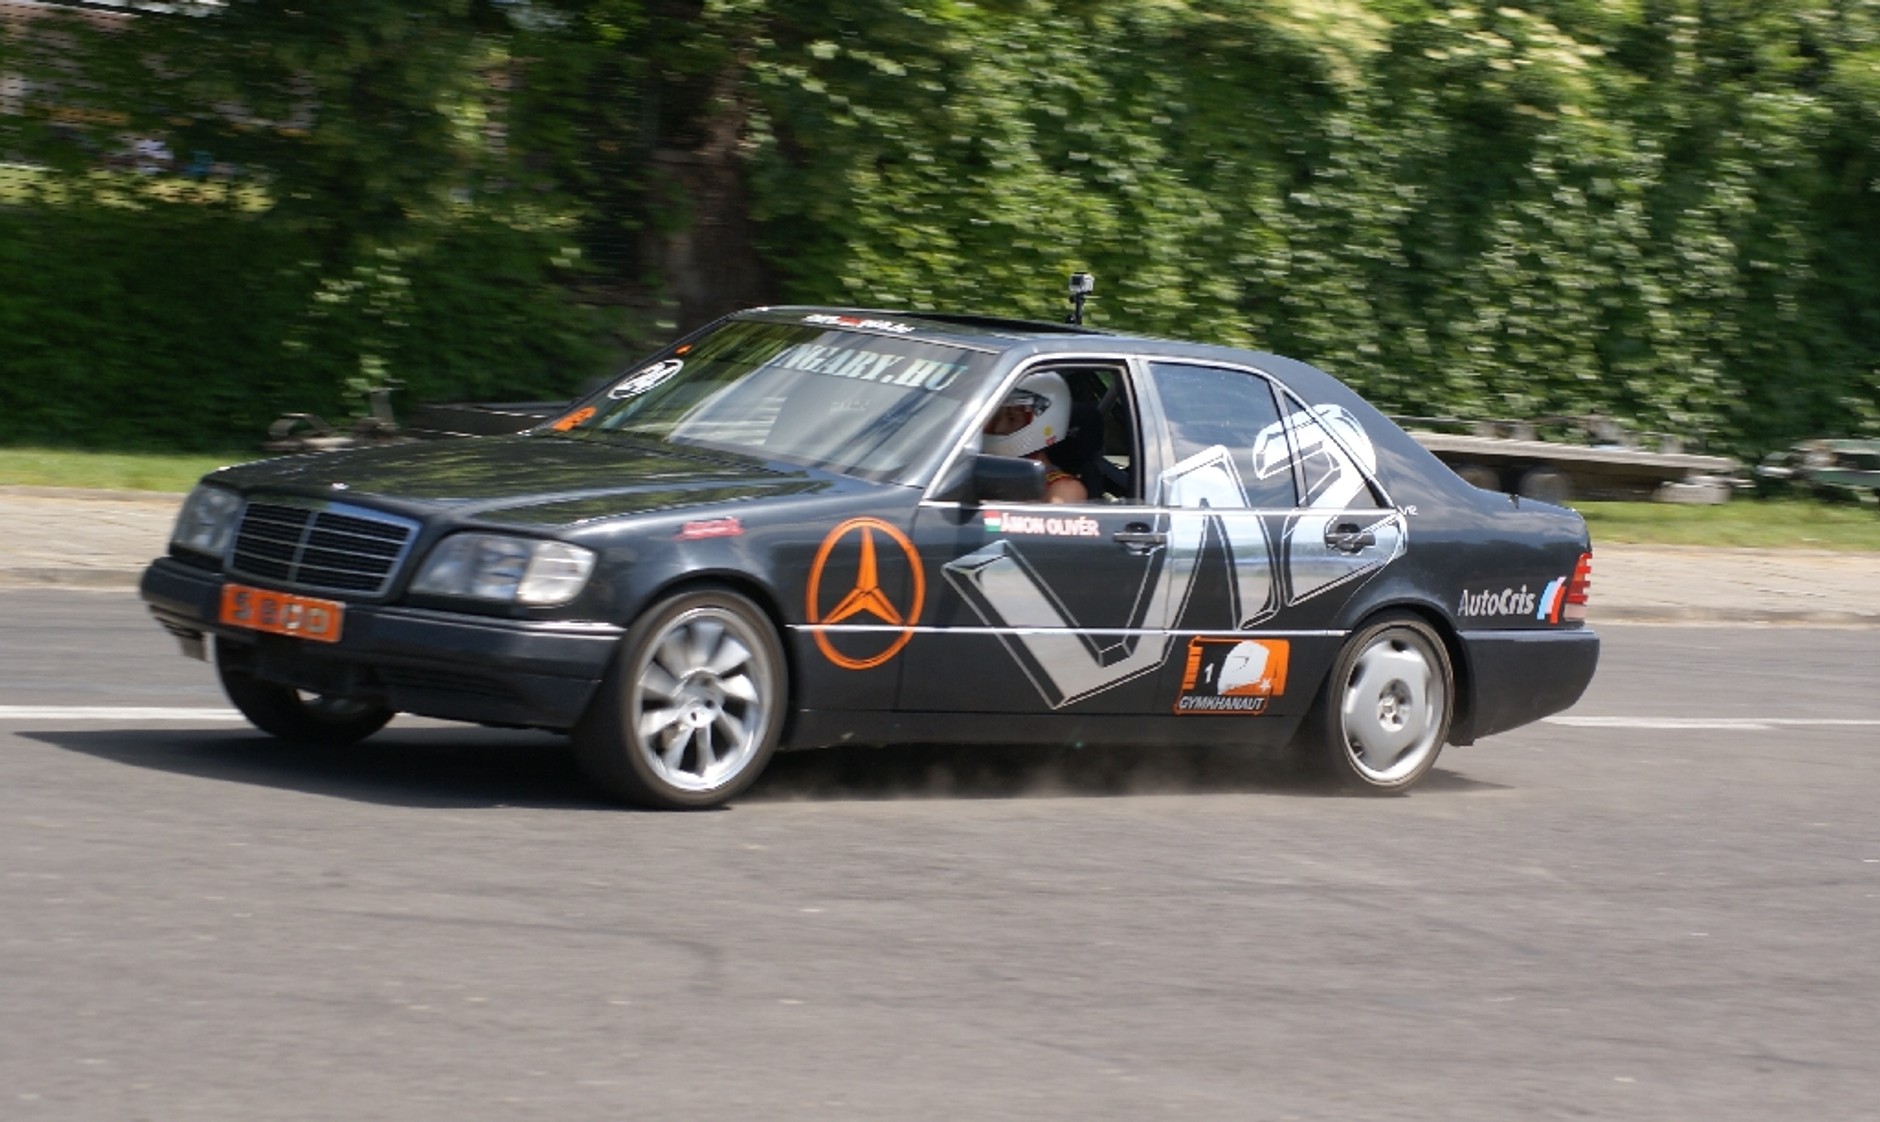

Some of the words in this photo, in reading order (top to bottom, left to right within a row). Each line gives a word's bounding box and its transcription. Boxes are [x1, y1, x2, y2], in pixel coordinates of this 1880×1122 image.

[1046, 516, 1100, 536] OLIVÉR
[1457, 584, 1536, 616] AutoCris
[1204, 662, 1215, 684] 1
[1178, 695, 1265, 710] GYMKHANAUT
